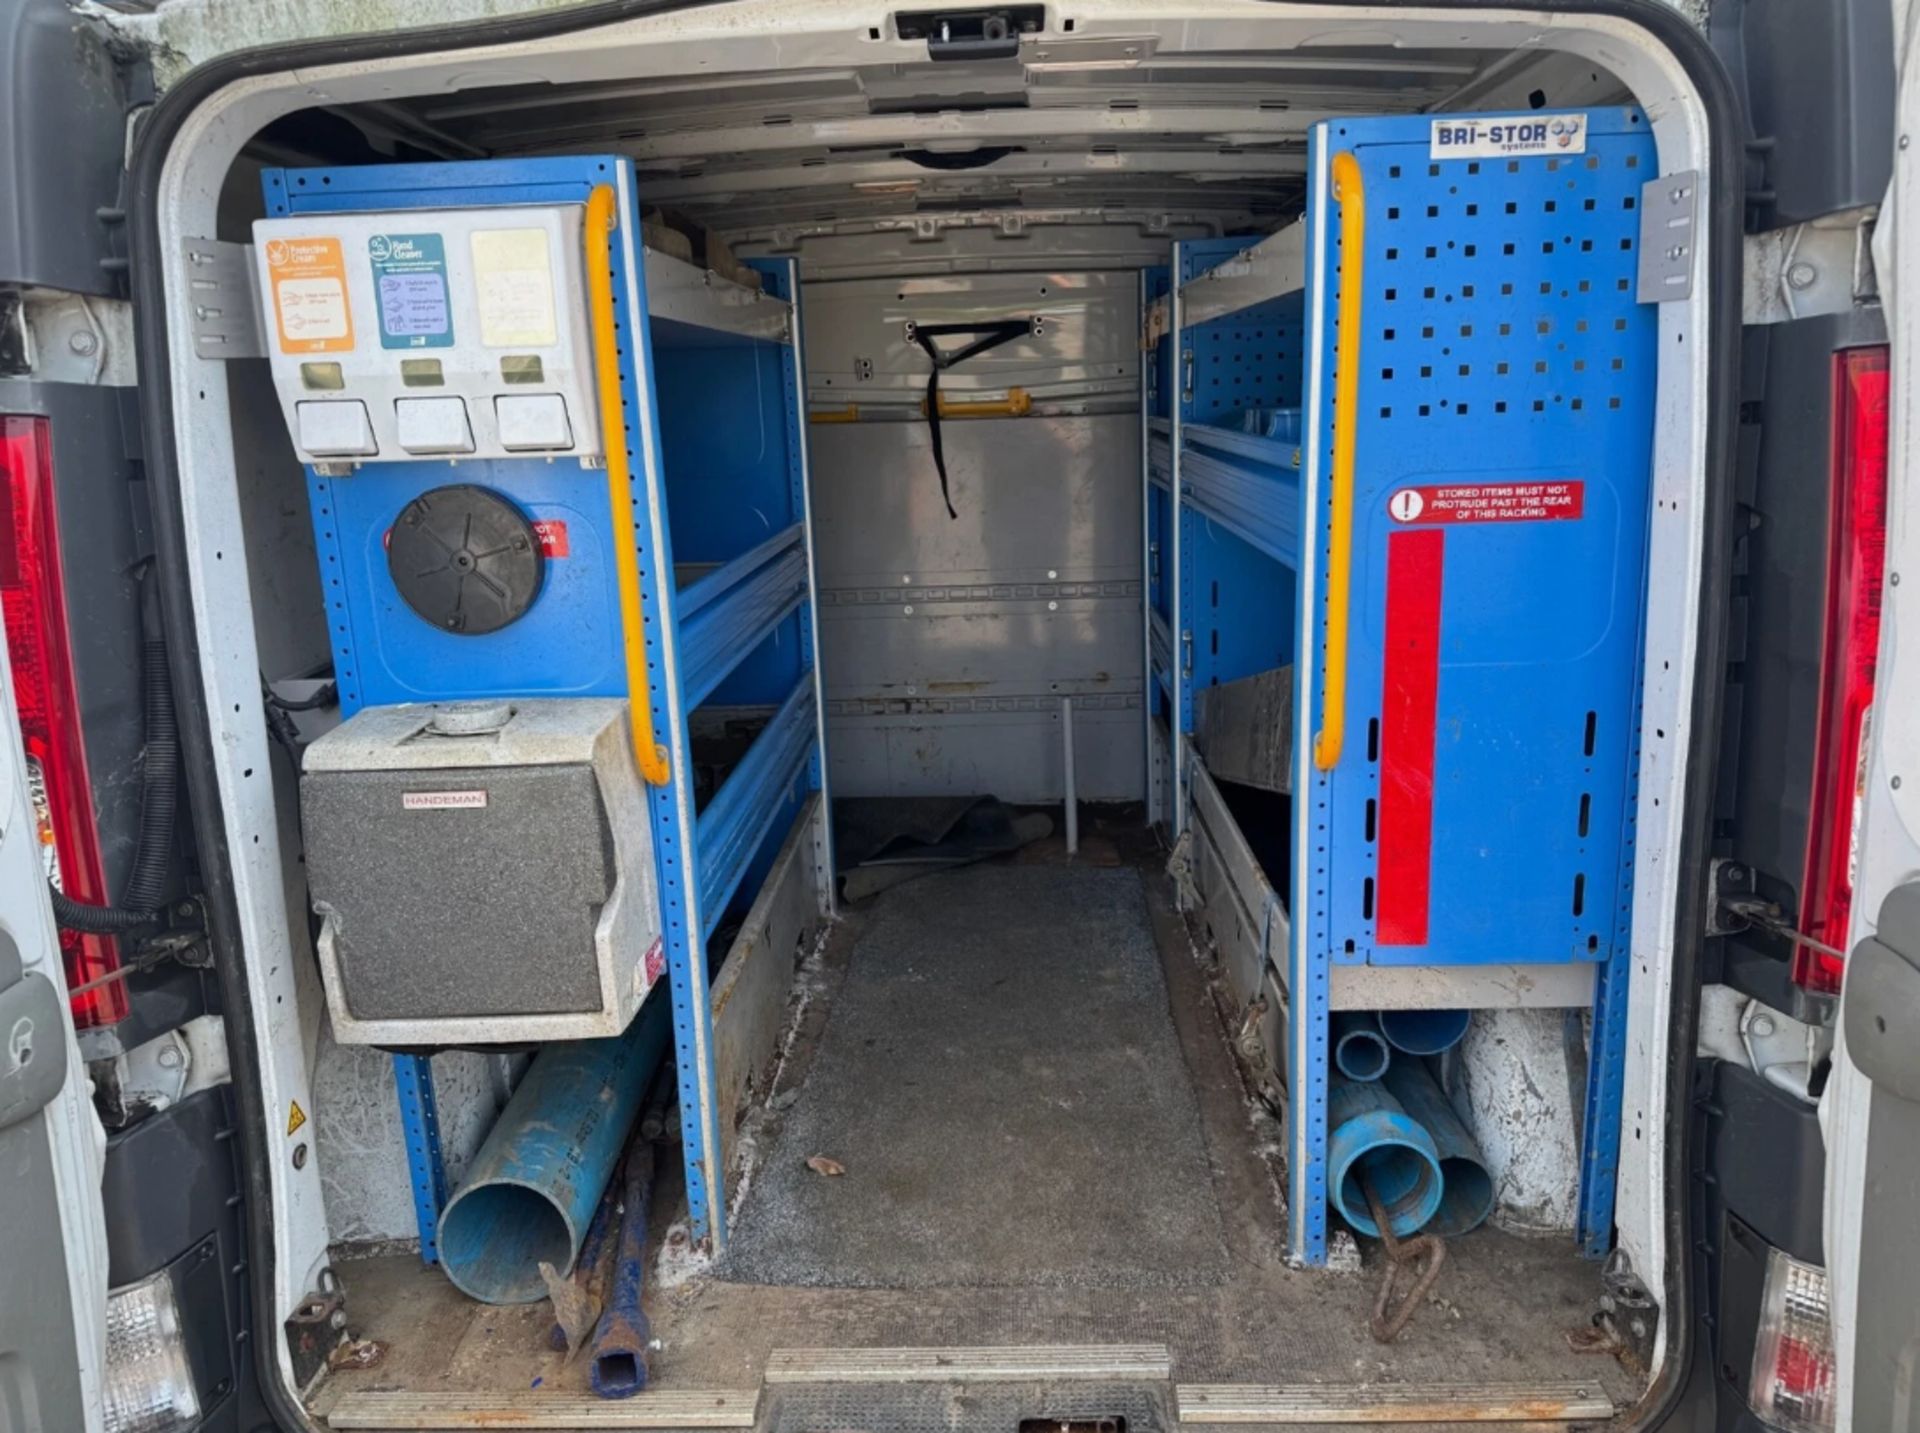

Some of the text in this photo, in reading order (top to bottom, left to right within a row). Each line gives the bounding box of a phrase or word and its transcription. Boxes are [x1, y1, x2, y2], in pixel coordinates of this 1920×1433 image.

[1438, 124, 1547, 145] BRI-STOR
[1501, 142, 1546, 152] systems
[392, 239, 413, 250] Hand
[393, 250, 423, 260] Cleaner
[1437, 485, 1568, 498] STORED ITEMS MUST NOT
[1431, 496, 1571, 509] PROTRUDE PAST THE REAR
[1456, 507, 1546, 519] OF THIS RACKING
